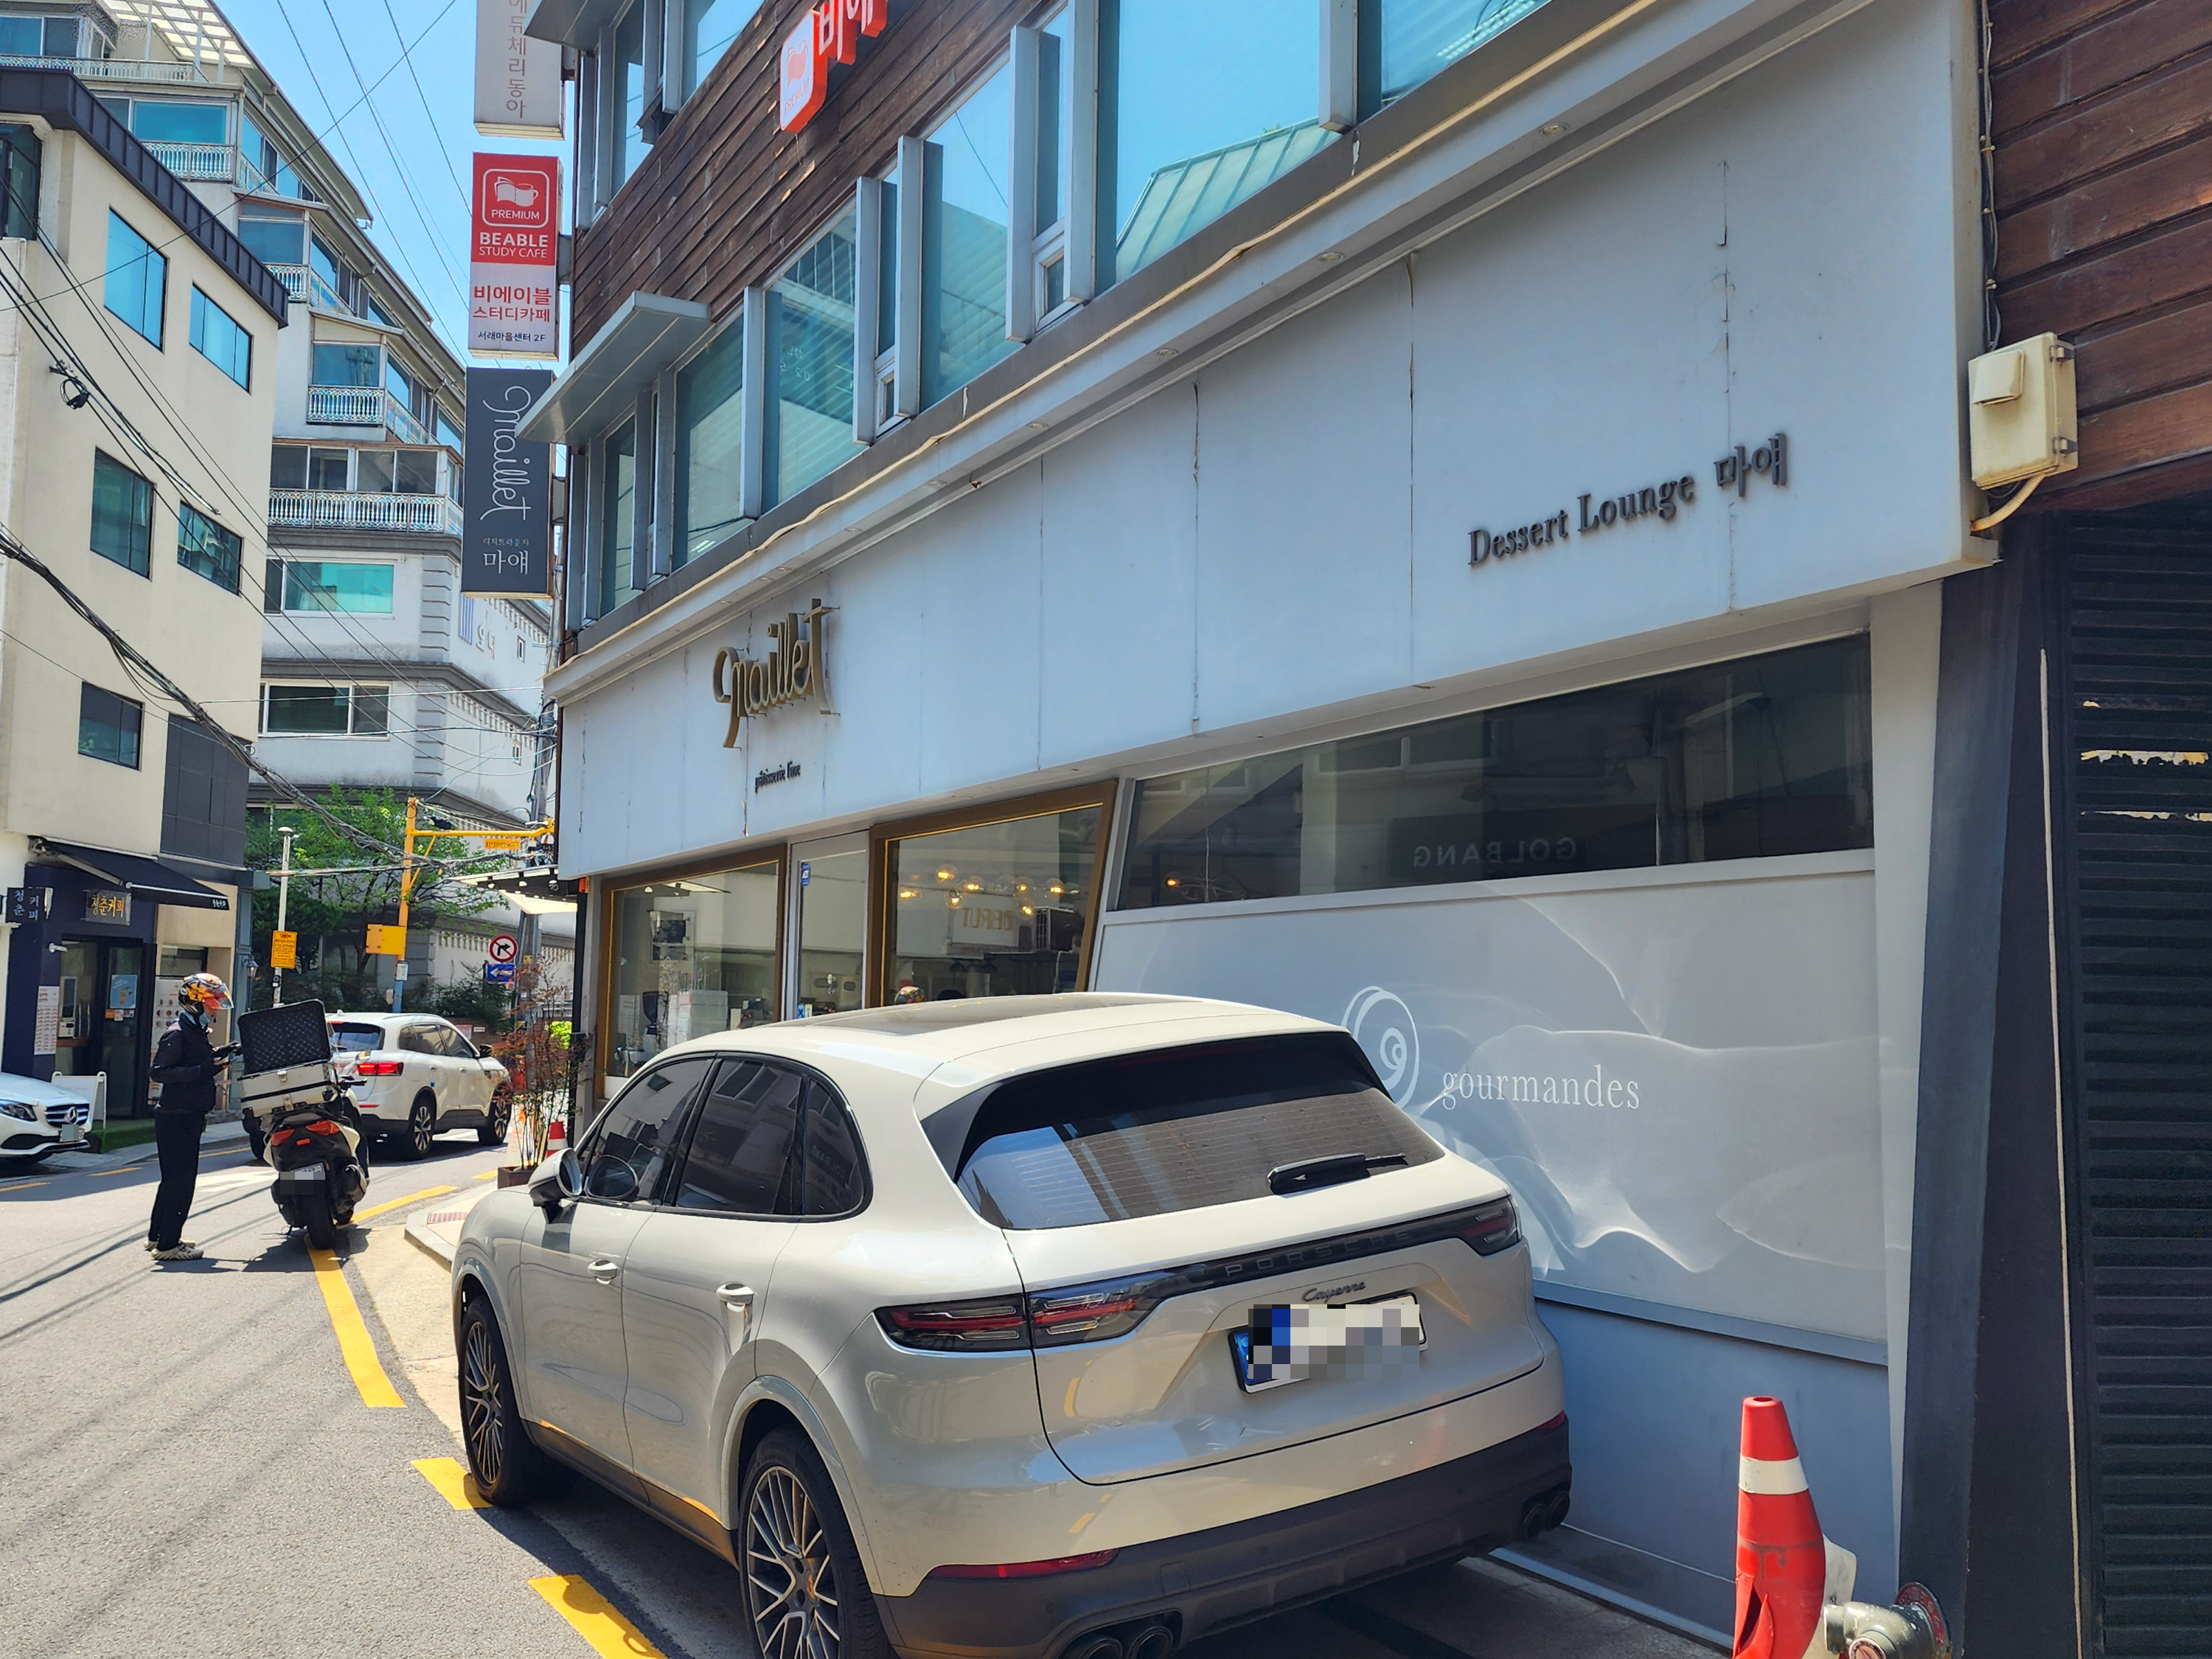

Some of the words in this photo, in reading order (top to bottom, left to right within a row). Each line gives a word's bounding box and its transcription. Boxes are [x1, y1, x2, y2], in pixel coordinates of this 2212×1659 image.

[491, 209, 540, 220] PREMIUM
[479, 232, 549, 248] BEABLE
[479, 246, 516, 257] STUDY
[518, 248, 547, 259] CAFE
[473, 285, 552, 305] 비에이블
[473, 306, 550, 323] 스터디카페
[478, 331, 531, 342] 서래마을센터
[534, 334, 546, 342] 2F
[1467, 509, 1569, 566] Dessert
[1576, 474, 1695, 532] Lounge
[91, 894, 125, 919] 청춘커피
[1442, 1063, 1640, 1110] gourmandes
[1224, 1229, 1411, 1277] PORSCHE
[1301, 1281, 1366, 1304] Cayenne
